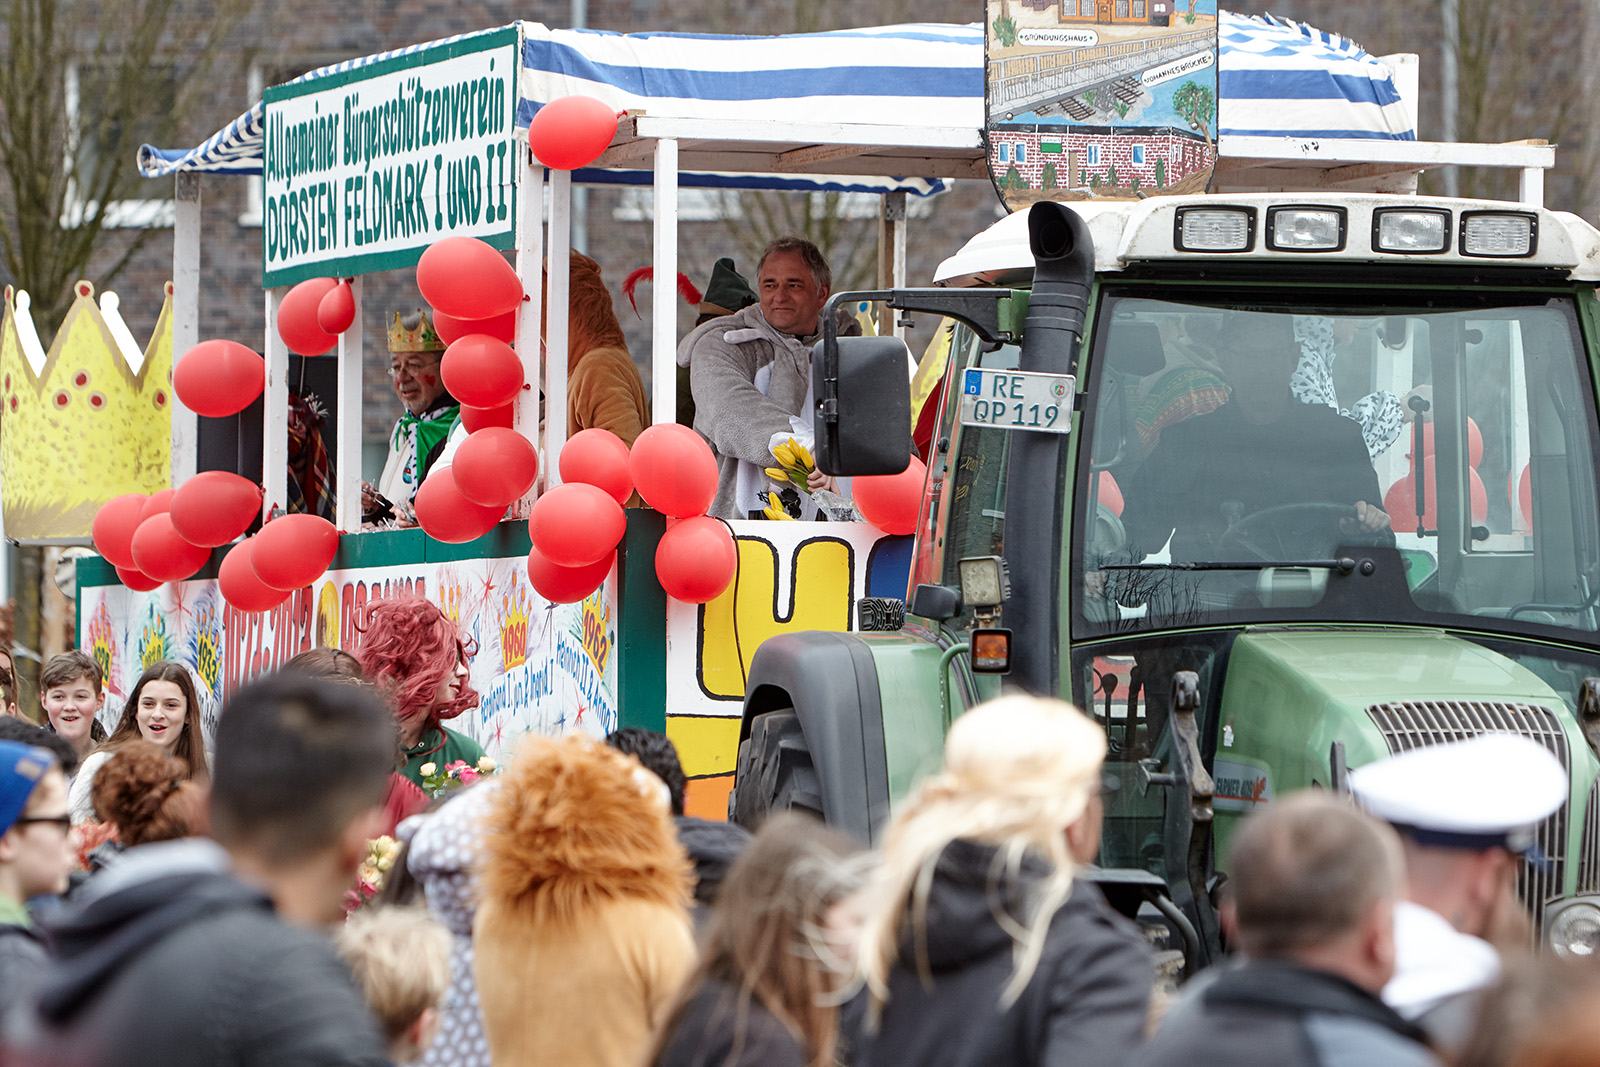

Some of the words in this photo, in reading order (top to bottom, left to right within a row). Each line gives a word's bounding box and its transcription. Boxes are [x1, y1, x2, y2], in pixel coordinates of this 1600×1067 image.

[267, 100, 339, 190] Allgemeiner
[343, 57, 505, 173] Bürgerschützenverein
[267, 180, 337, 262] DORSTEN
[344, 159, 429, 248] FELDMARK
[434, 154, 443, 231] I
[447, 154, 482, 230] UND
[486, 140, 507, 223] II
[970, 385, 977, 394] D
[992, 375, 1025, 399] RE
[974, 400, 1006, 423] QP
[1012, 402, 1059, 427] 119
[503, 620, 526, 666] 1960
[584, 608, 607, 674] 1962
